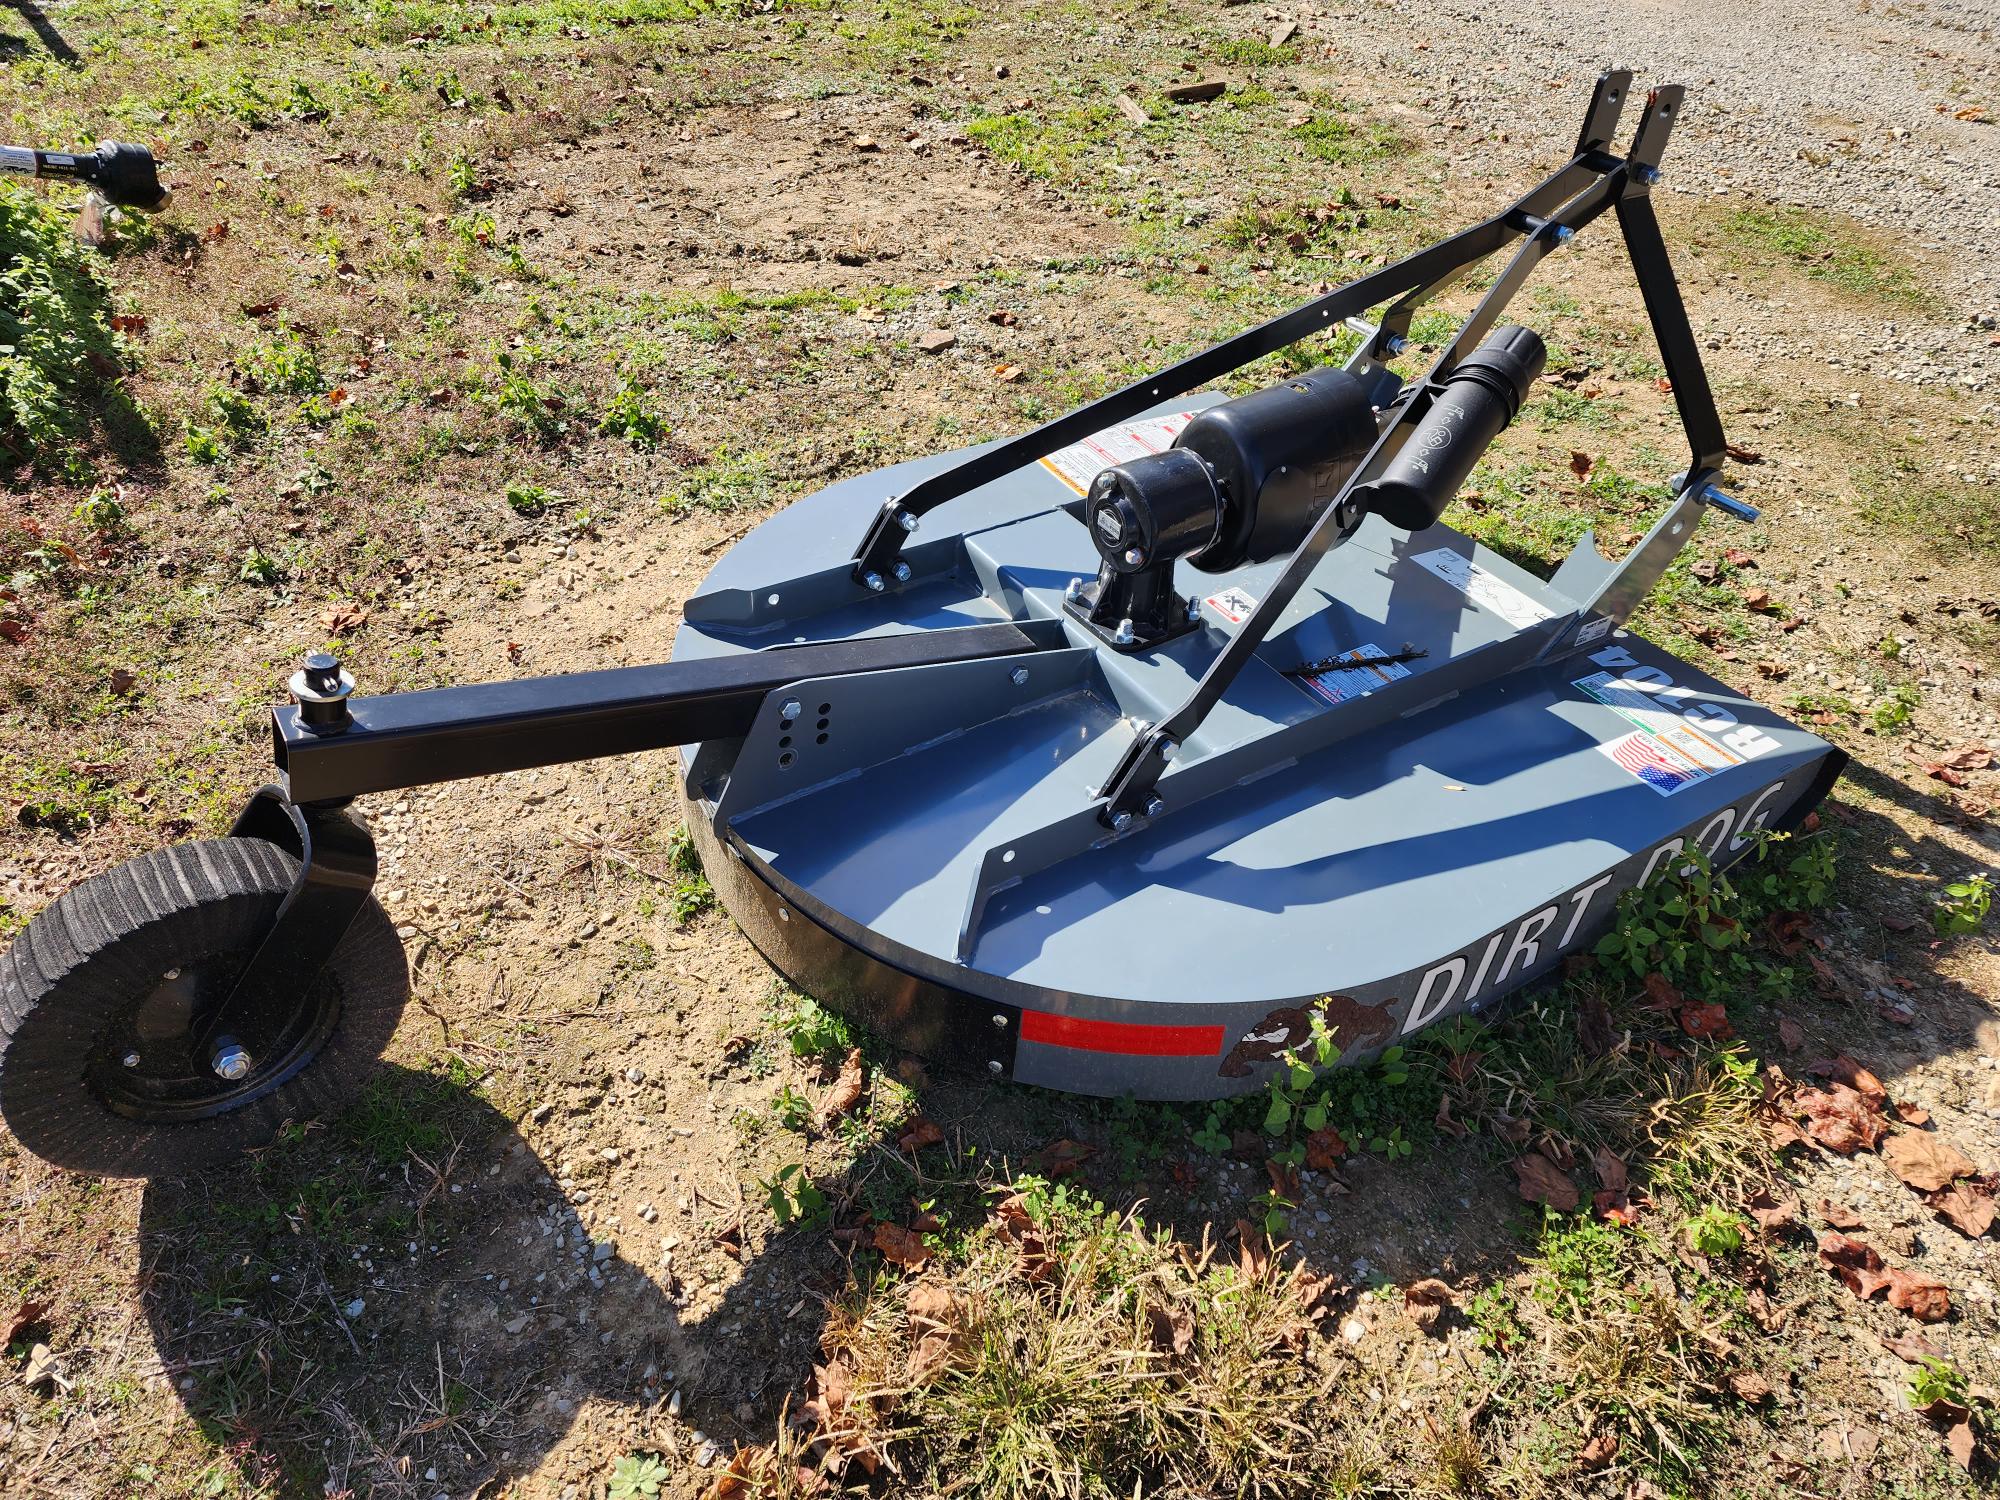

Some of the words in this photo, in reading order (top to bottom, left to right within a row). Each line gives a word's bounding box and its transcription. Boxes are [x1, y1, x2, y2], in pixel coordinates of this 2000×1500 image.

[1587, 646, 1783, 760] RC104
[1400, 873, 1613, 1036] DIRT
[1635, 780, 1785, 890] DOG
